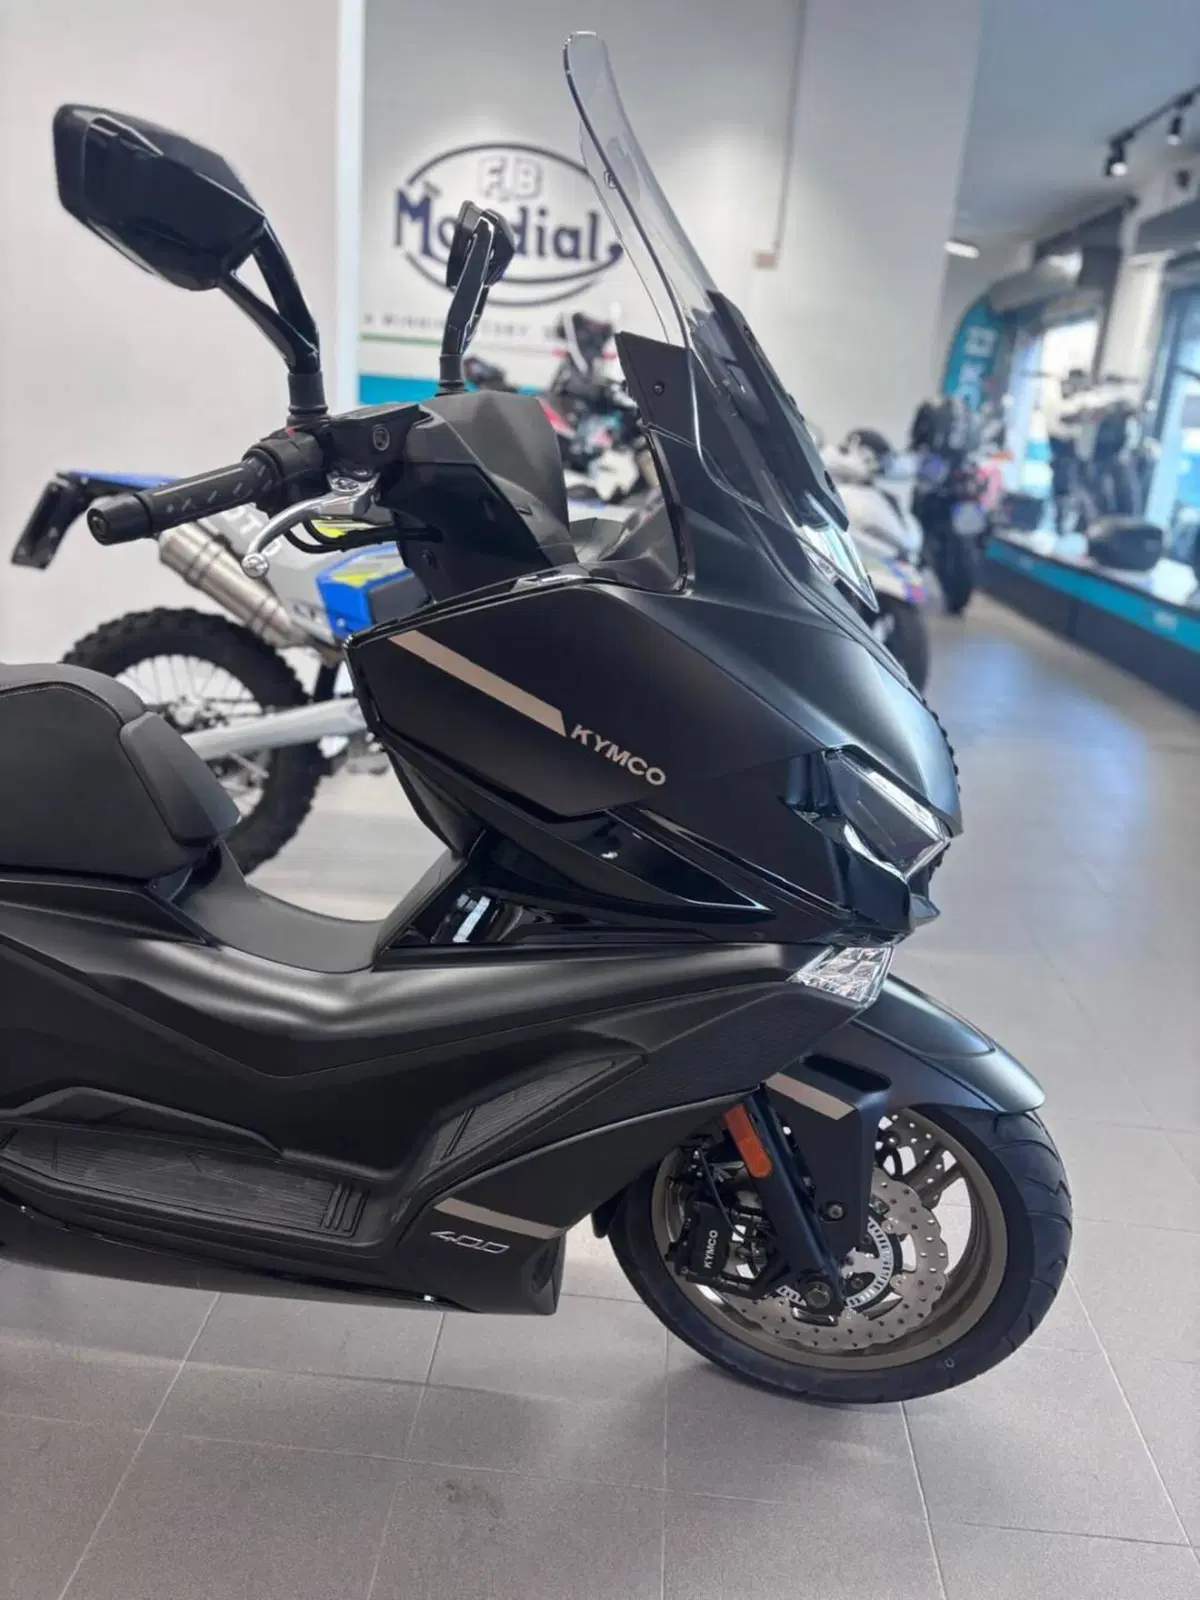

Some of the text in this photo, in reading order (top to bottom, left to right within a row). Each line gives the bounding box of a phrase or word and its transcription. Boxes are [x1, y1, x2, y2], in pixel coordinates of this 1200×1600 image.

[394, 186, 600, 262] Modial
[570, 724, 667, 786] KYMCO
[430, 1230, 511, 1255] 400
[703, 1229, 719, 1270] KYMCO
